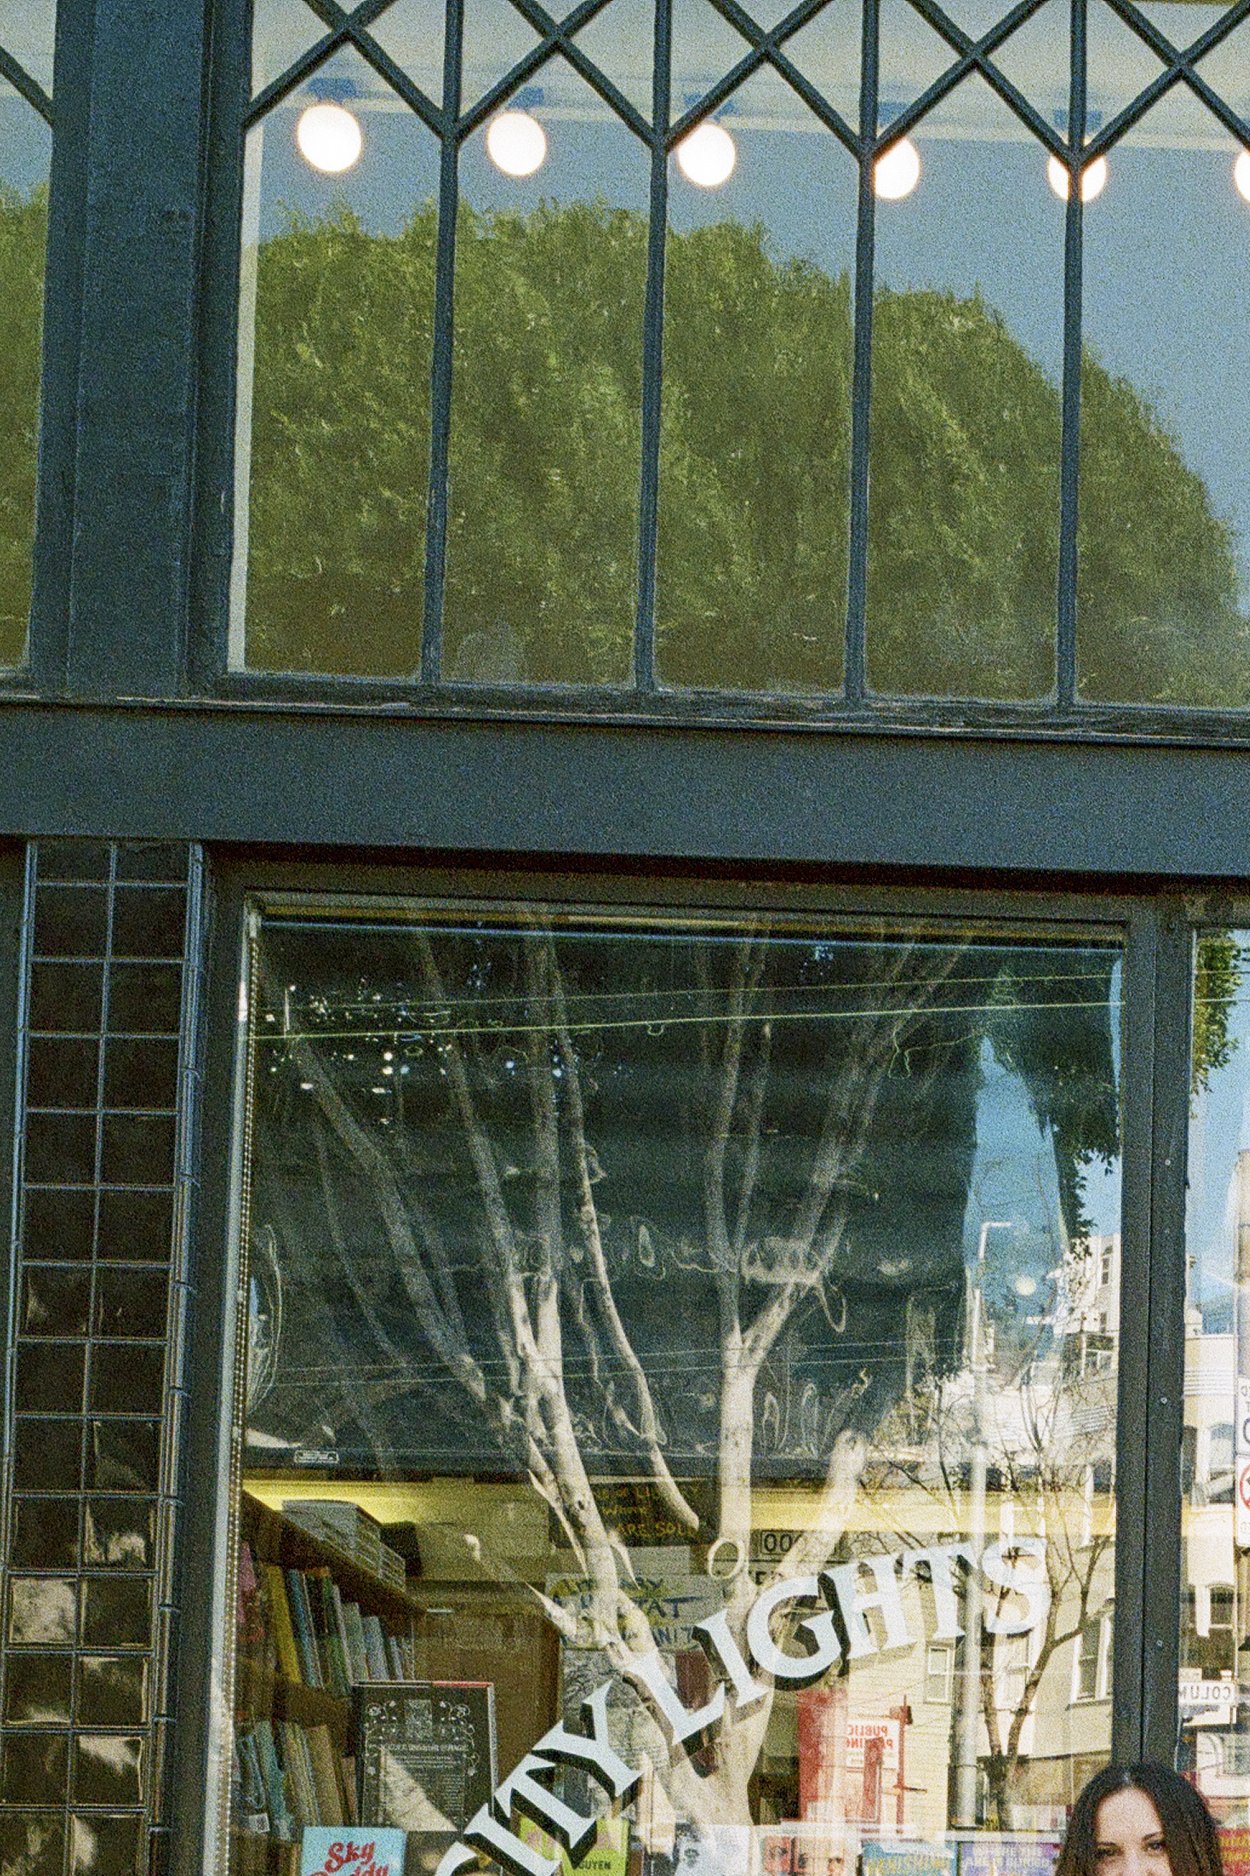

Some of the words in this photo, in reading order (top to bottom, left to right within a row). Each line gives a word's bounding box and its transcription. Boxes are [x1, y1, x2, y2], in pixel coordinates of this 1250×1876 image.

[617, 1536, 1050, 1747] LIGHTS
[324, 1840, 376, 1872] Sky
[576, 1859, 611, 1871] GUYEN
